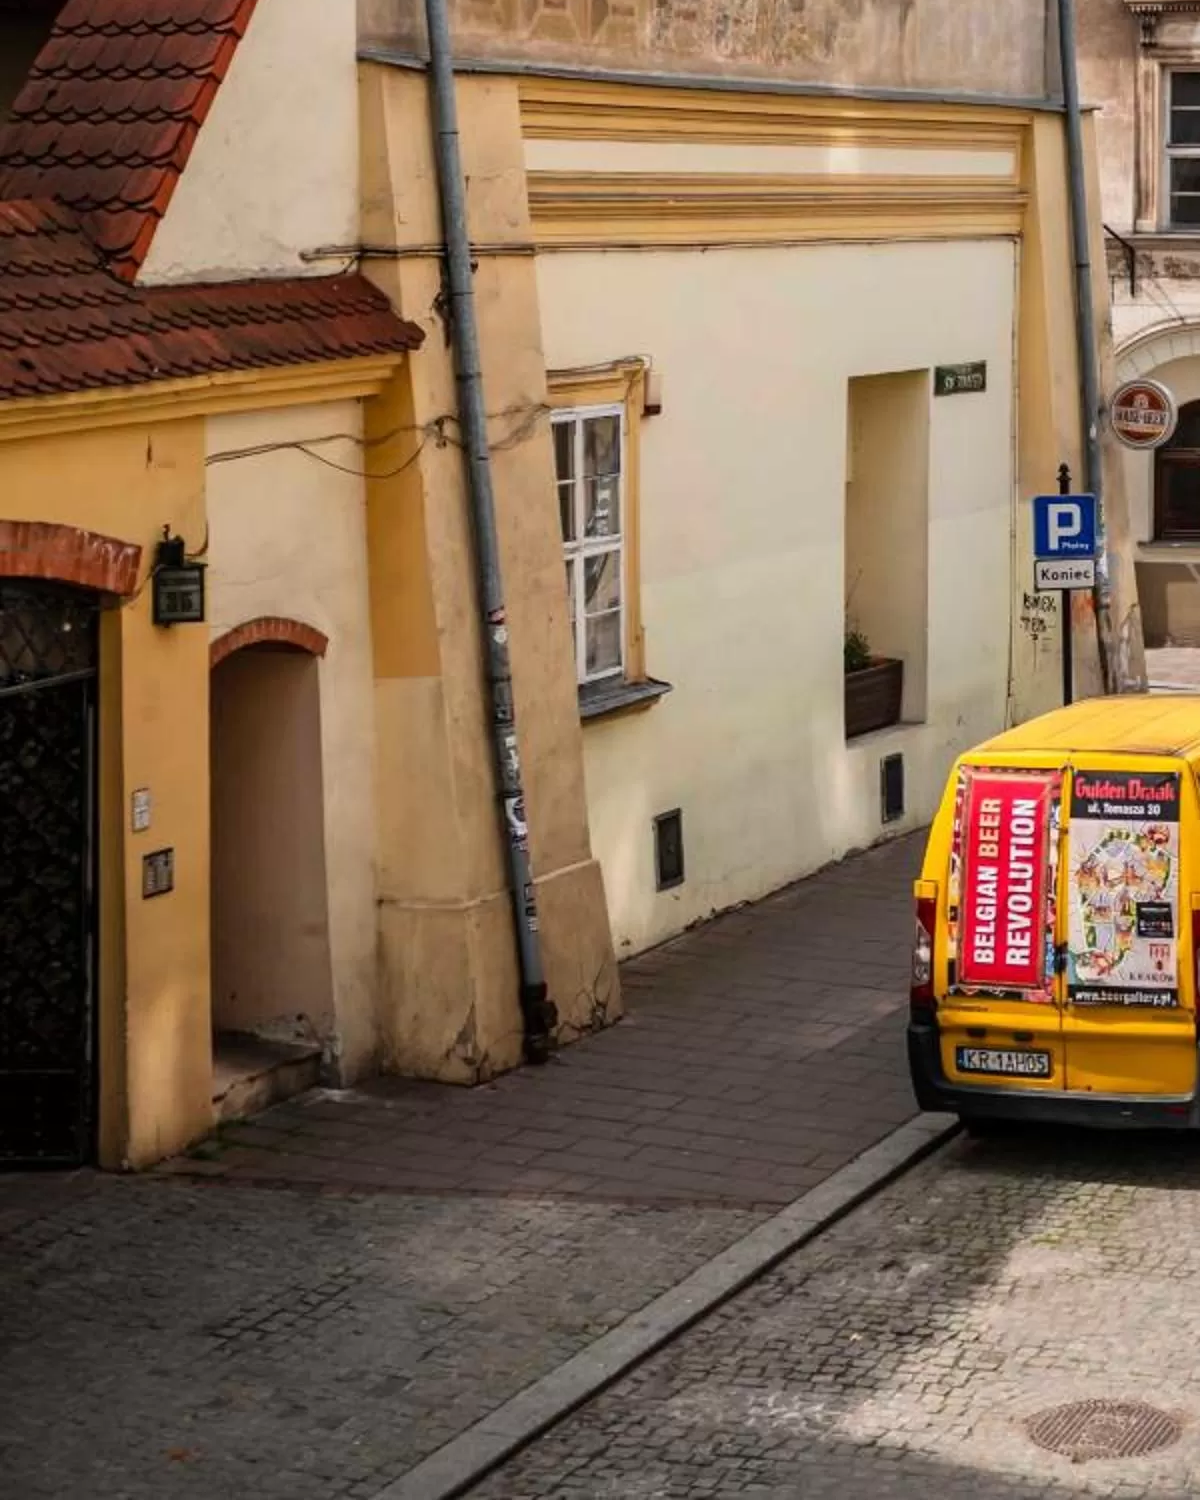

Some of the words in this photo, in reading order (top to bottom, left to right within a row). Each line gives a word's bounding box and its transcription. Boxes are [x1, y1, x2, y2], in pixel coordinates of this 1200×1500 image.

[1047, 503, 1081, 550] P
[1041, 567, 1090, 581] Koniec
[978, 798, 1002, 858] BEER
[1005, 799, 1038, 966] REVOLUTION
[974, 866, 999, 964] BELGIAN
